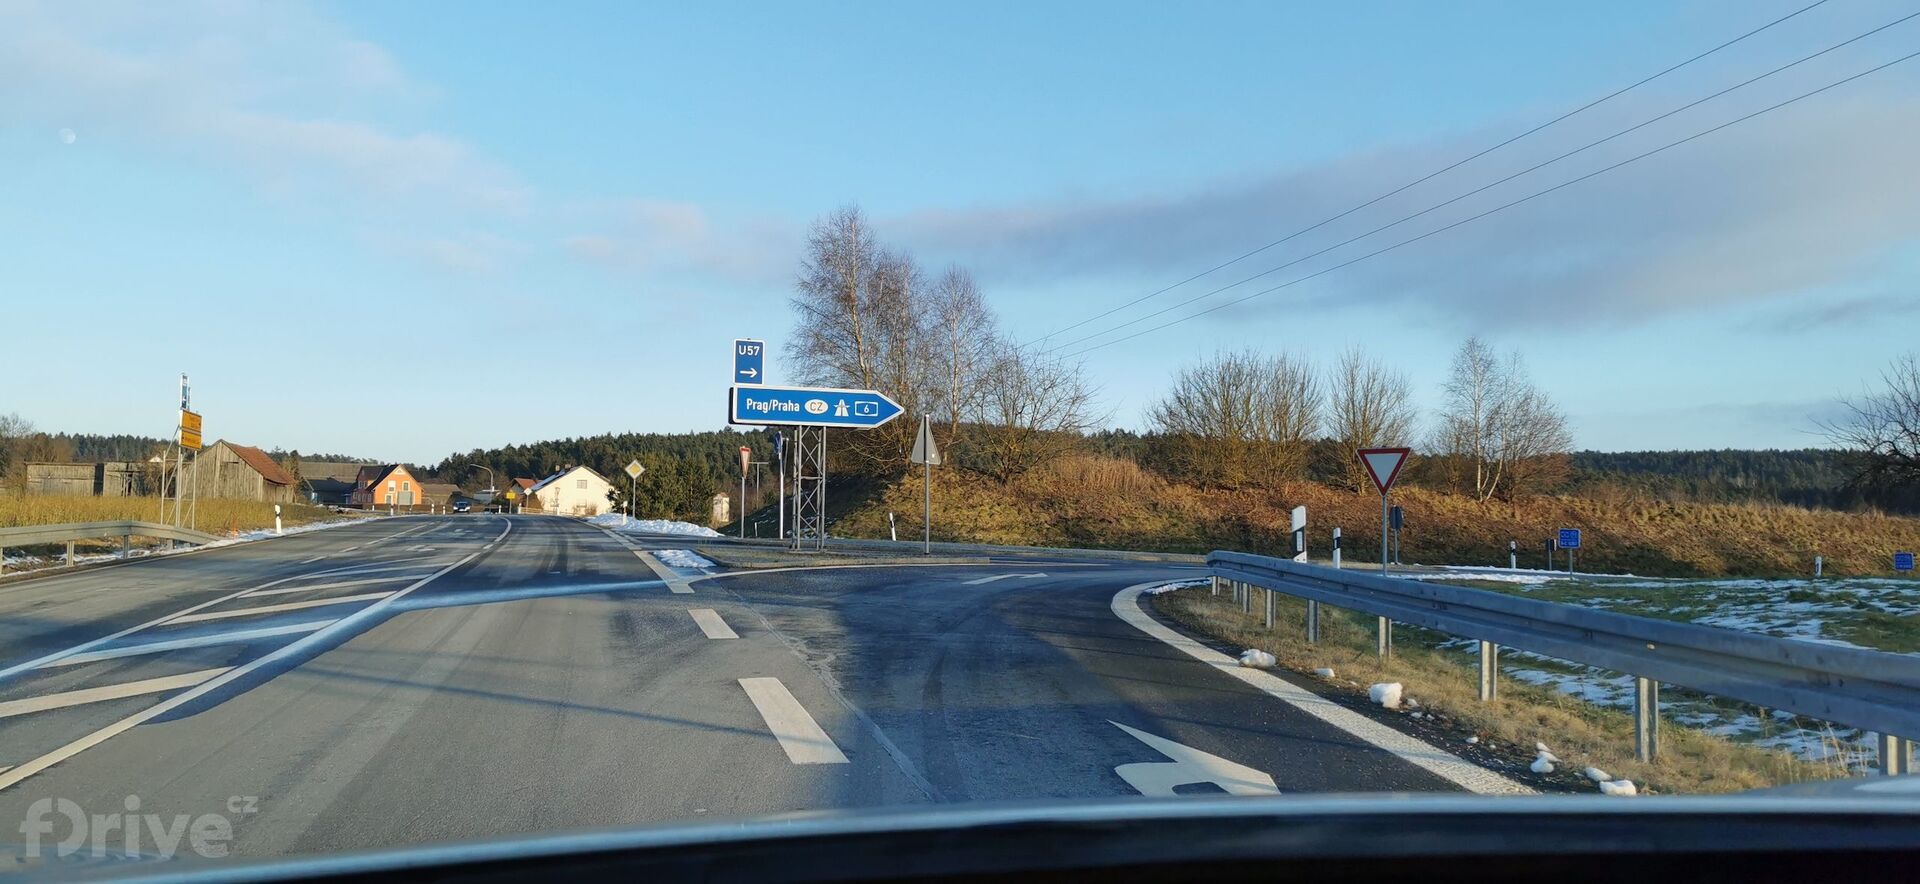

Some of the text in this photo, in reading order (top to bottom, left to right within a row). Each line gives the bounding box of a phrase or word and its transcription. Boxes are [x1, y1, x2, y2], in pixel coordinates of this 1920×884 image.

[738, 345, 760, 356] U57
[746, 399, 870, 413] Prag/Praha CZ 6
